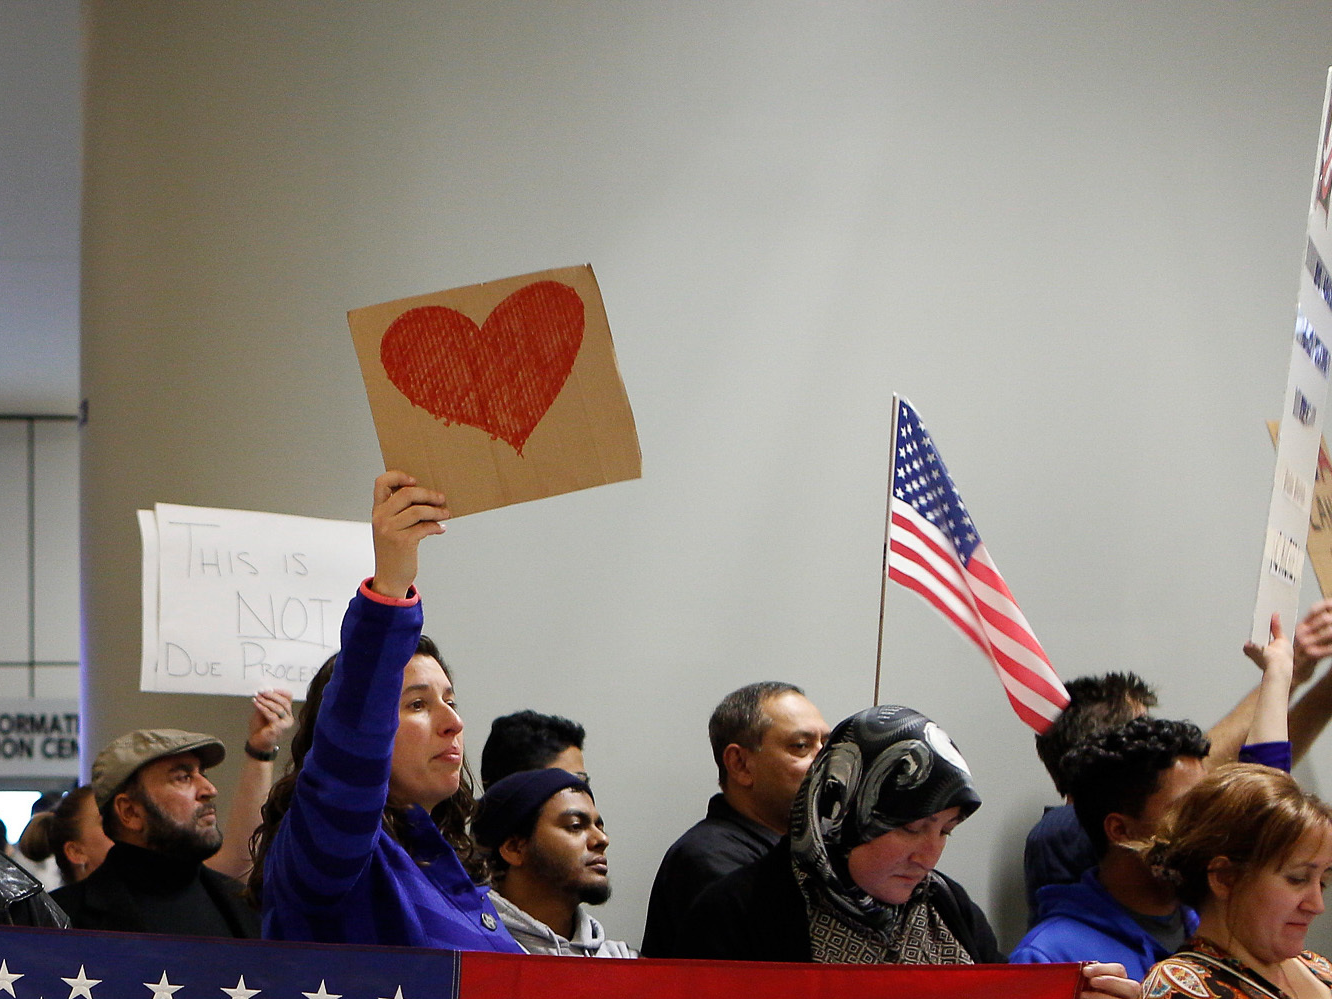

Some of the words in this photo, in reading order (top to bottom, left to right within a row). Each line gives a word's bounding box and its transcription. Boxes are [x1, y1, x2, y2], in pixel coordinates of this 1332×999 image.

[168, 521, 259, 579] THIS
[284, 552, 309, 577] IS
[236, 590, 334, 649] NOT
[165, 641, 223, 678] DUE
